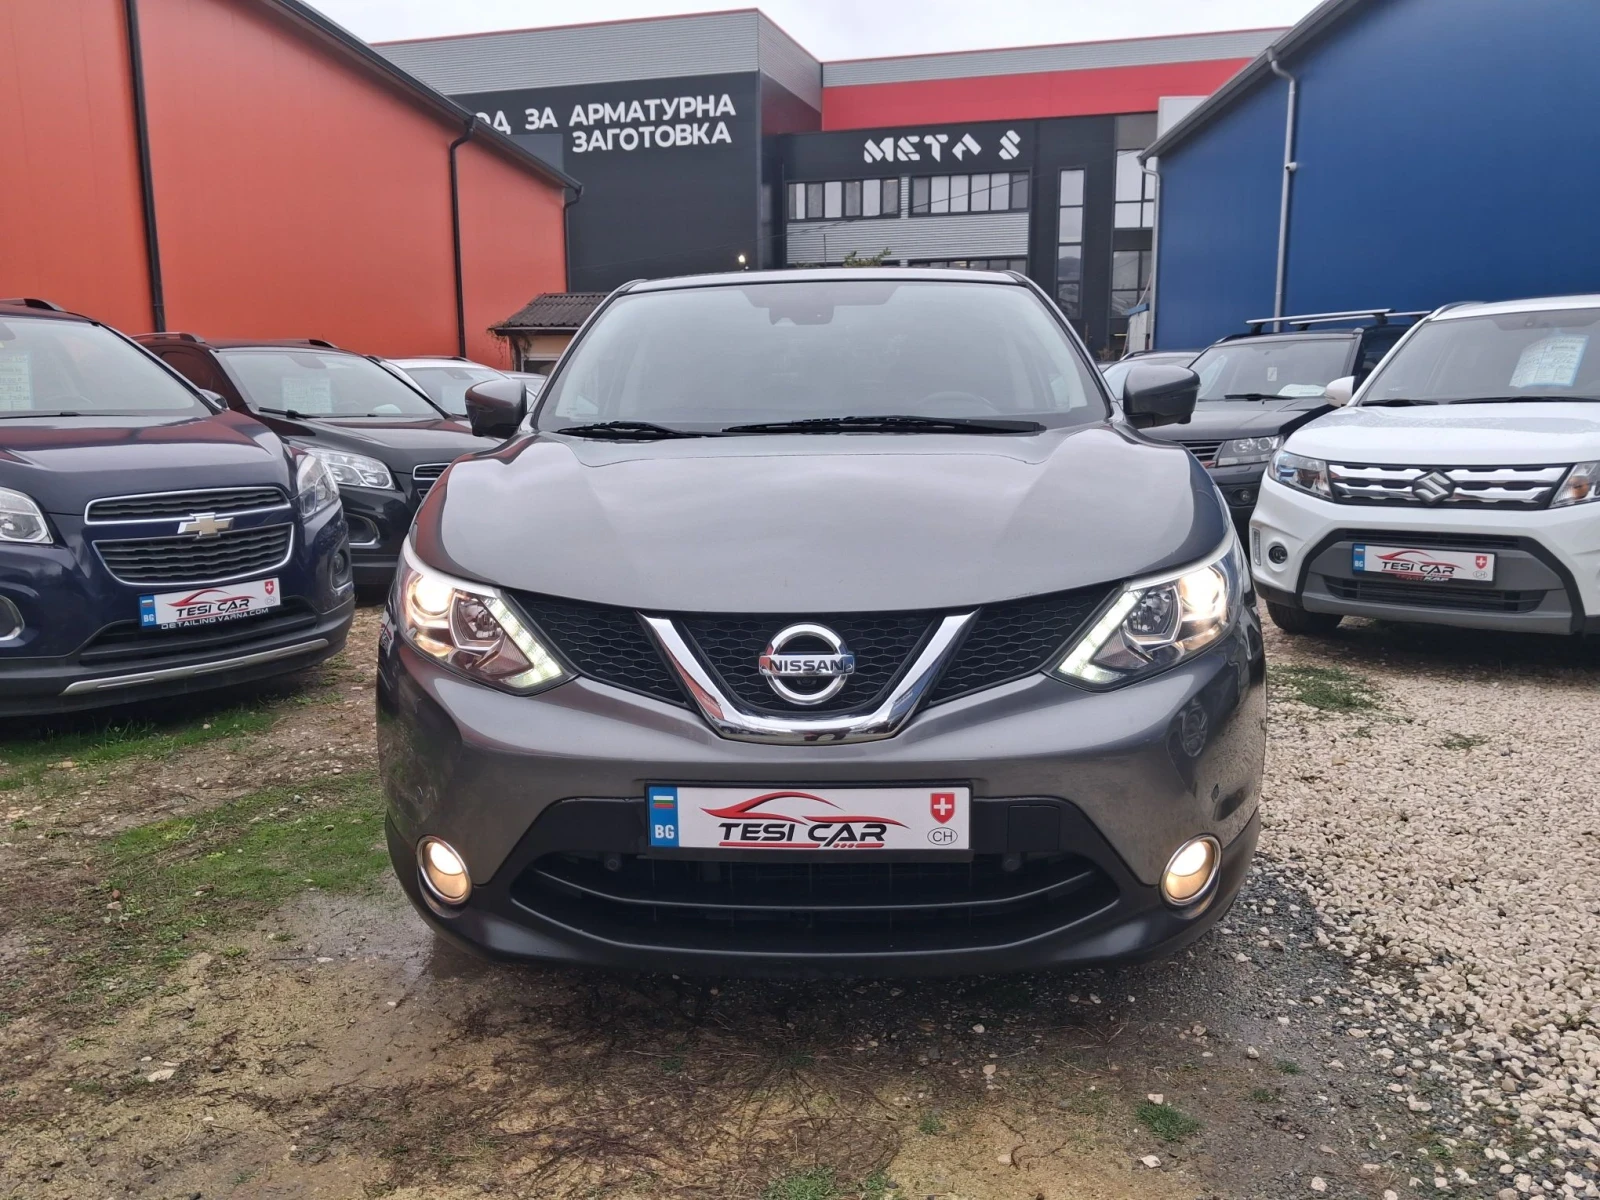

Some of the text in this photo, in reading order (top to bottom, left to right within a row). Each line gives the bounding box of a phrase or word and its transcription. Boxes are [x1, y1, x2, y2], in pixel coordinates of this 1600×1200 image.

[525, 106, 559, 130] ЗА
[568, 94, 737, 127] АРМАТУРНА
[572, 121, 733, 153] ЗАГОТОВКА
[863, 133, 982, 164] META
[1354, 560, 1364, 568] BG
[1382, 561, 1455, 575] TESI CAR
[176, 598, 250, 618] TESI CAR
[143, 614, 154, 623] BG
[769, 659, 843, 672] NISSAN
[654, 824, 675, 839] BG
[718, 822, 887, 847] TESI CAR
[932, 831, 953, 842] CH
